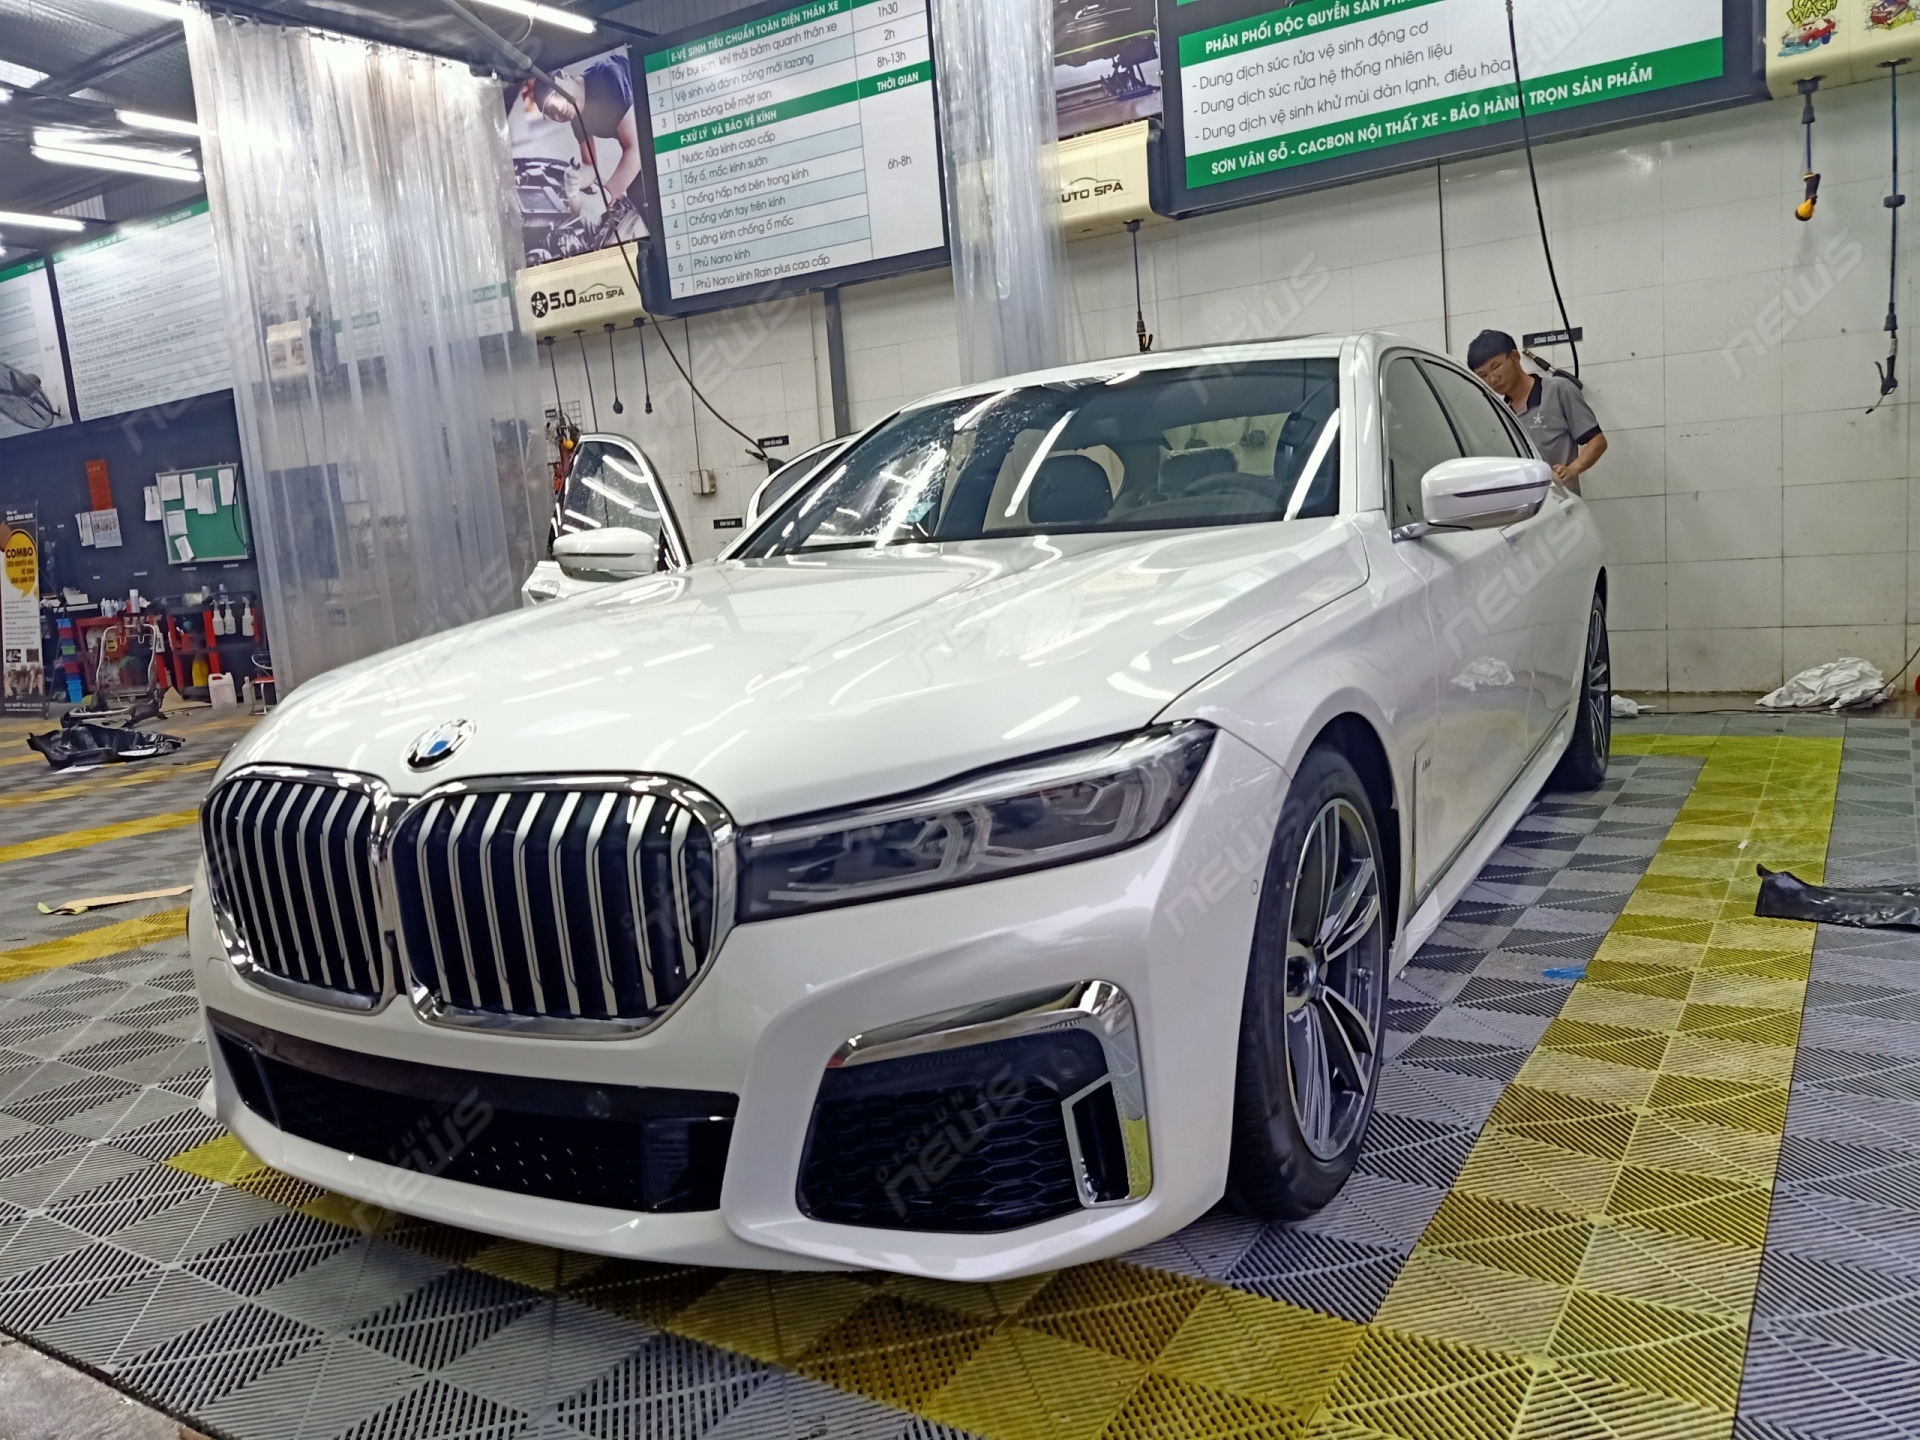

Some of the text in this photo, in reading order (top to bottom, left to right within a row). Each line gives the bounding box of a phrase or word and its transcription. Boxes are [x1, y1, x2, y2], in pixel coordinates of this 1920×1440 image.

[877, 2, 898, 18] 1h30
[671, 0, 839, 63] E-VỆ SINH TIÊU CHUẨN TOÀN DIỆN THÂN XE
[884, 29, 895, 41] 2h
[1205, 33, 1239, 54] PHÂN
[1241, 20, 1272, 45] PHỐI
[1274, 16, 1304, 37] ĐỘC
[1307, 1, 1350, 28] QUYỀN
[877, 51, 906, 68] 8h-13h
[1199, 71, 1233, 91] Dung
[1236, 63, 1264, 82] dịch
[1267, 56, 1290, 73] súc
[1292, 49, 1315, 67] rửa
[1317, 43, 1335, 60] vệ
[1338, 37, 1364, 55] sinh
[1367, 28, 1405, 48] động
[1409, 21, 1429, 37] cơ
[877, 71, 919, 92] THỜI GIAN
[1200, 96, 1234, 115] Dung
[1237, 88, 1266, 107] dịch
[1268, 81, 1292, 98] súc
[1294, 75, 1316, 92] rửa
[1319, 68, 1337, 87] hệ
[1340, 61, 1381, 81] thống
[1385, 50, 1424, 70] nhiên
[1427, 44, 1453, 61] liệu
[1202, 122, 1236, 141] Dung
[1238, 114, 1267, 134] dịch
[1269, 108, 1286, 125] vệ
[1289, 102, 1314, 119] sinh
[1317, 93, 1342, 113] khử
[1345, 89, 1370, 106] mùi
[1373, 80, 1402, 100] dàn
[1405, 74, 1440, 94] lạnh,
[1444, 64, 1477, 85] điều
[1480, 57, 1511, 76] hòa
[680, 109, 778, 145] F-XỬ LÝ VÀ BẢO VỆ KÍNH
[1211, 155, 1236, 175] SƠN
[1238, 149, 1265, 169] VÂN
[1268, 141, 1288, 162] GỖ
[1298, 134, 1354, 156] CACBON
[1358, 123, 1382, 145] NỘI
[1385, 113, 1418, 136] THẤT
[1421, 112, 1439, 128] XE
[1450, 100, 1480, 122] BẢO
[1529, 84, 1568, 105] TRỌN
[1572, 75, 1602, 97] SẢN
[1607, 62, 1652, 89] PHẨM
[888, 154, 912, 169] 6h-8h
[671, 167, 810, 209] 3 Chống hấp hơi bên trong kính
[1094, 182, 1124, 196] SPA
[673, 219, 678, 229] 4
[689, 210, 716, 227] Chống
[735, 204, 749, 218] tay
[750, 199, 767, 213] trên
[768, 195, 786, 208] kính
[675, 215, 794, 250] 5 Dưỡng kính chống ố mốc
[678, 248, 750, 272] 6 Phủ Nano kính
[696, 275, 711, 290] Phủ
[712, 272, 735, 286] Nano
[736, 268, 753, 283] kính
[754, 264, 773, 278] Rain
[774, 260, 791, 276] plus
[792, 257, 811, 270] cao
[811, 253, 830, 268] cấp
[549, 288, 625, 310] 5.0 AUTO SPA
[6, 547, 33, 558] COMBO
